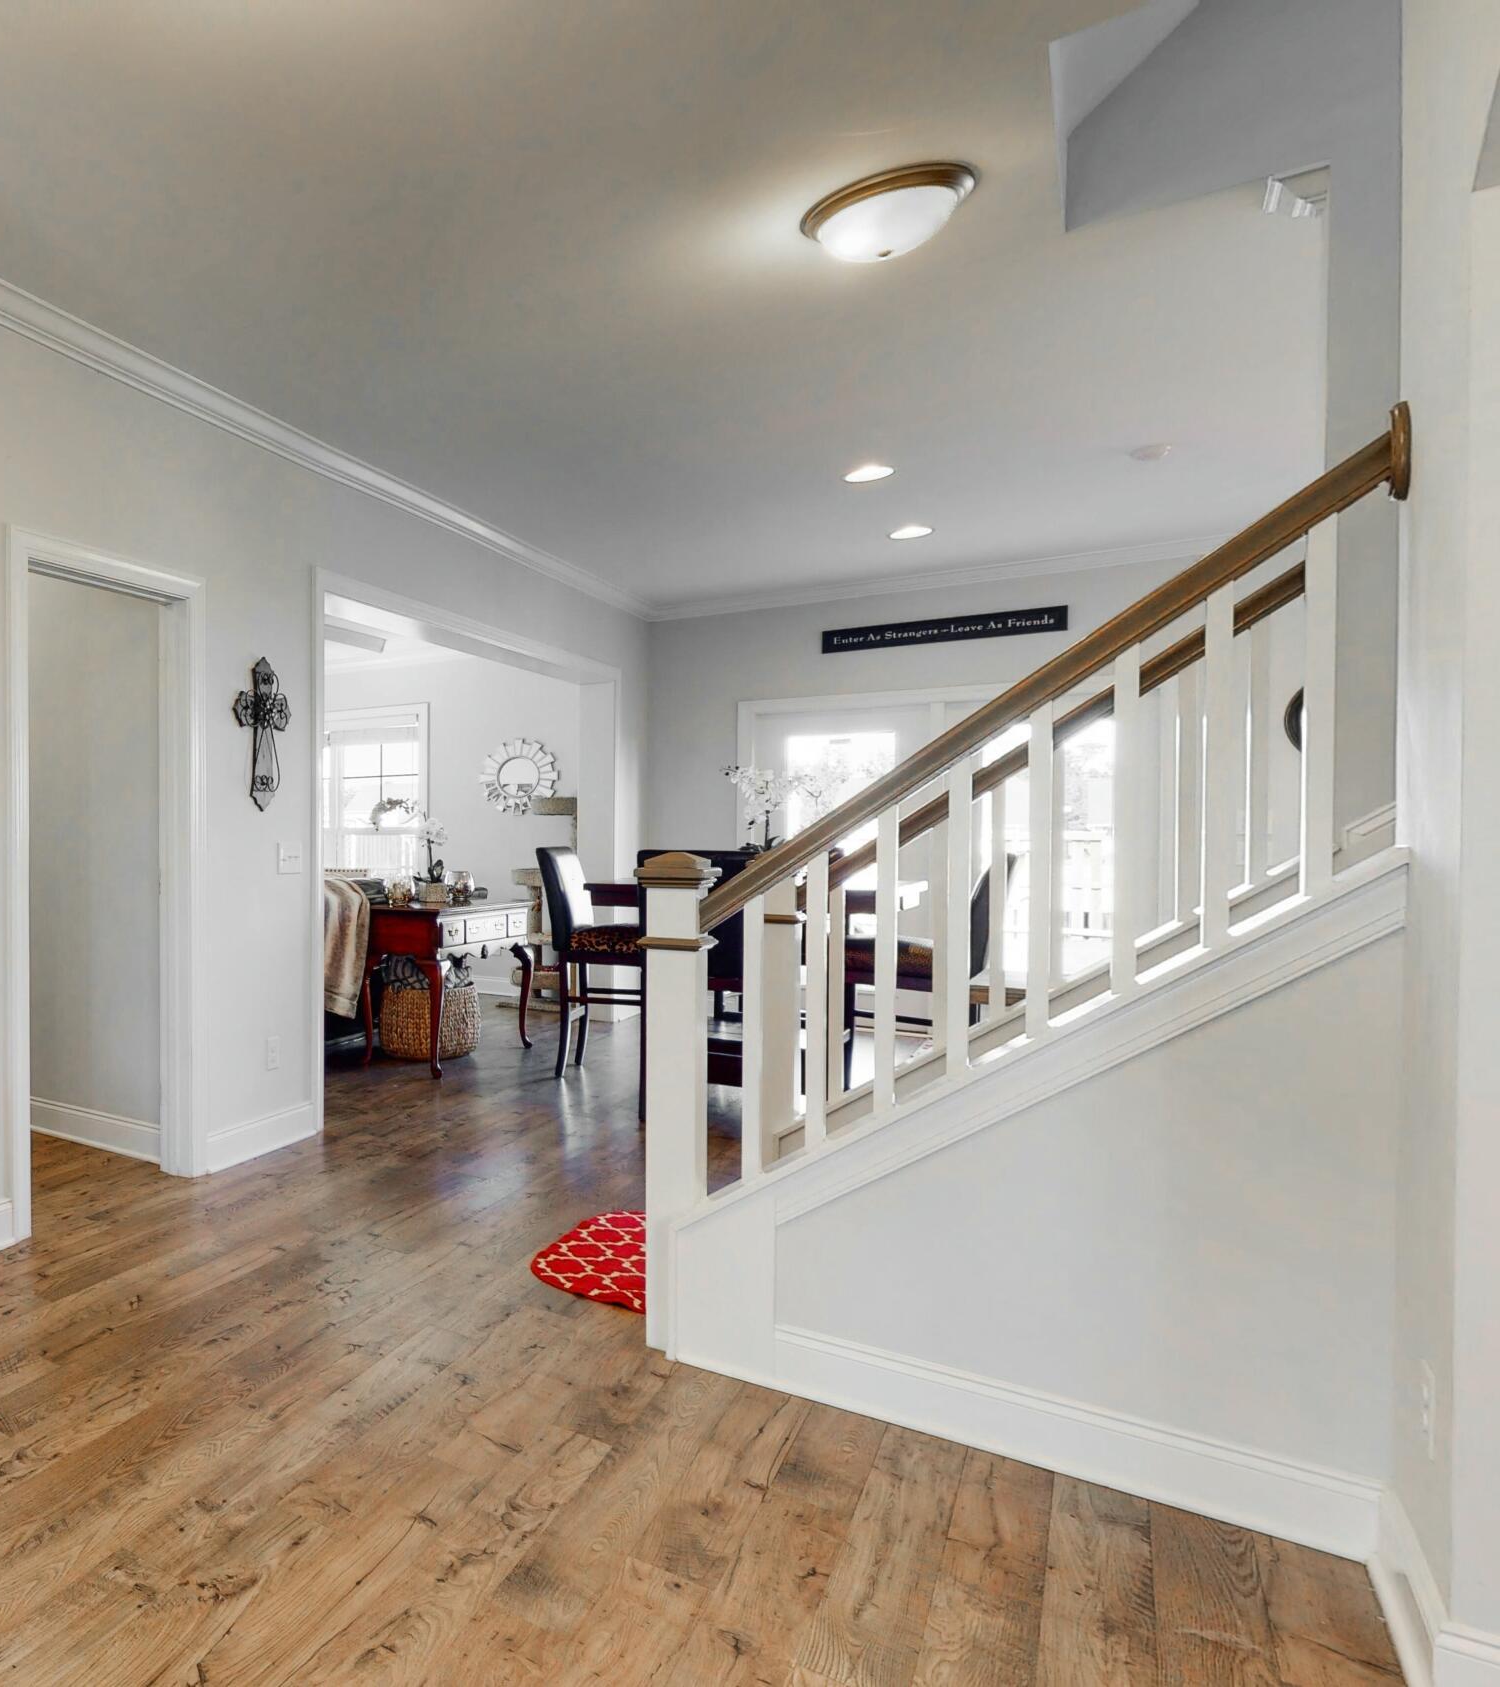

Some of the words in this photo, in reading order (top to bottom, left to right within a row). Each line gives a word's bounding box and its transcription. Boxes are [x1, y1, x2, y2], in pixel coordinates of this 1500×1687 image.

[833, 636, 864, 645] Enter
[867, 632, 881, 641] As
[986, 620, 1003, 630] As
[1007, 614, 1055, 628] Friends
